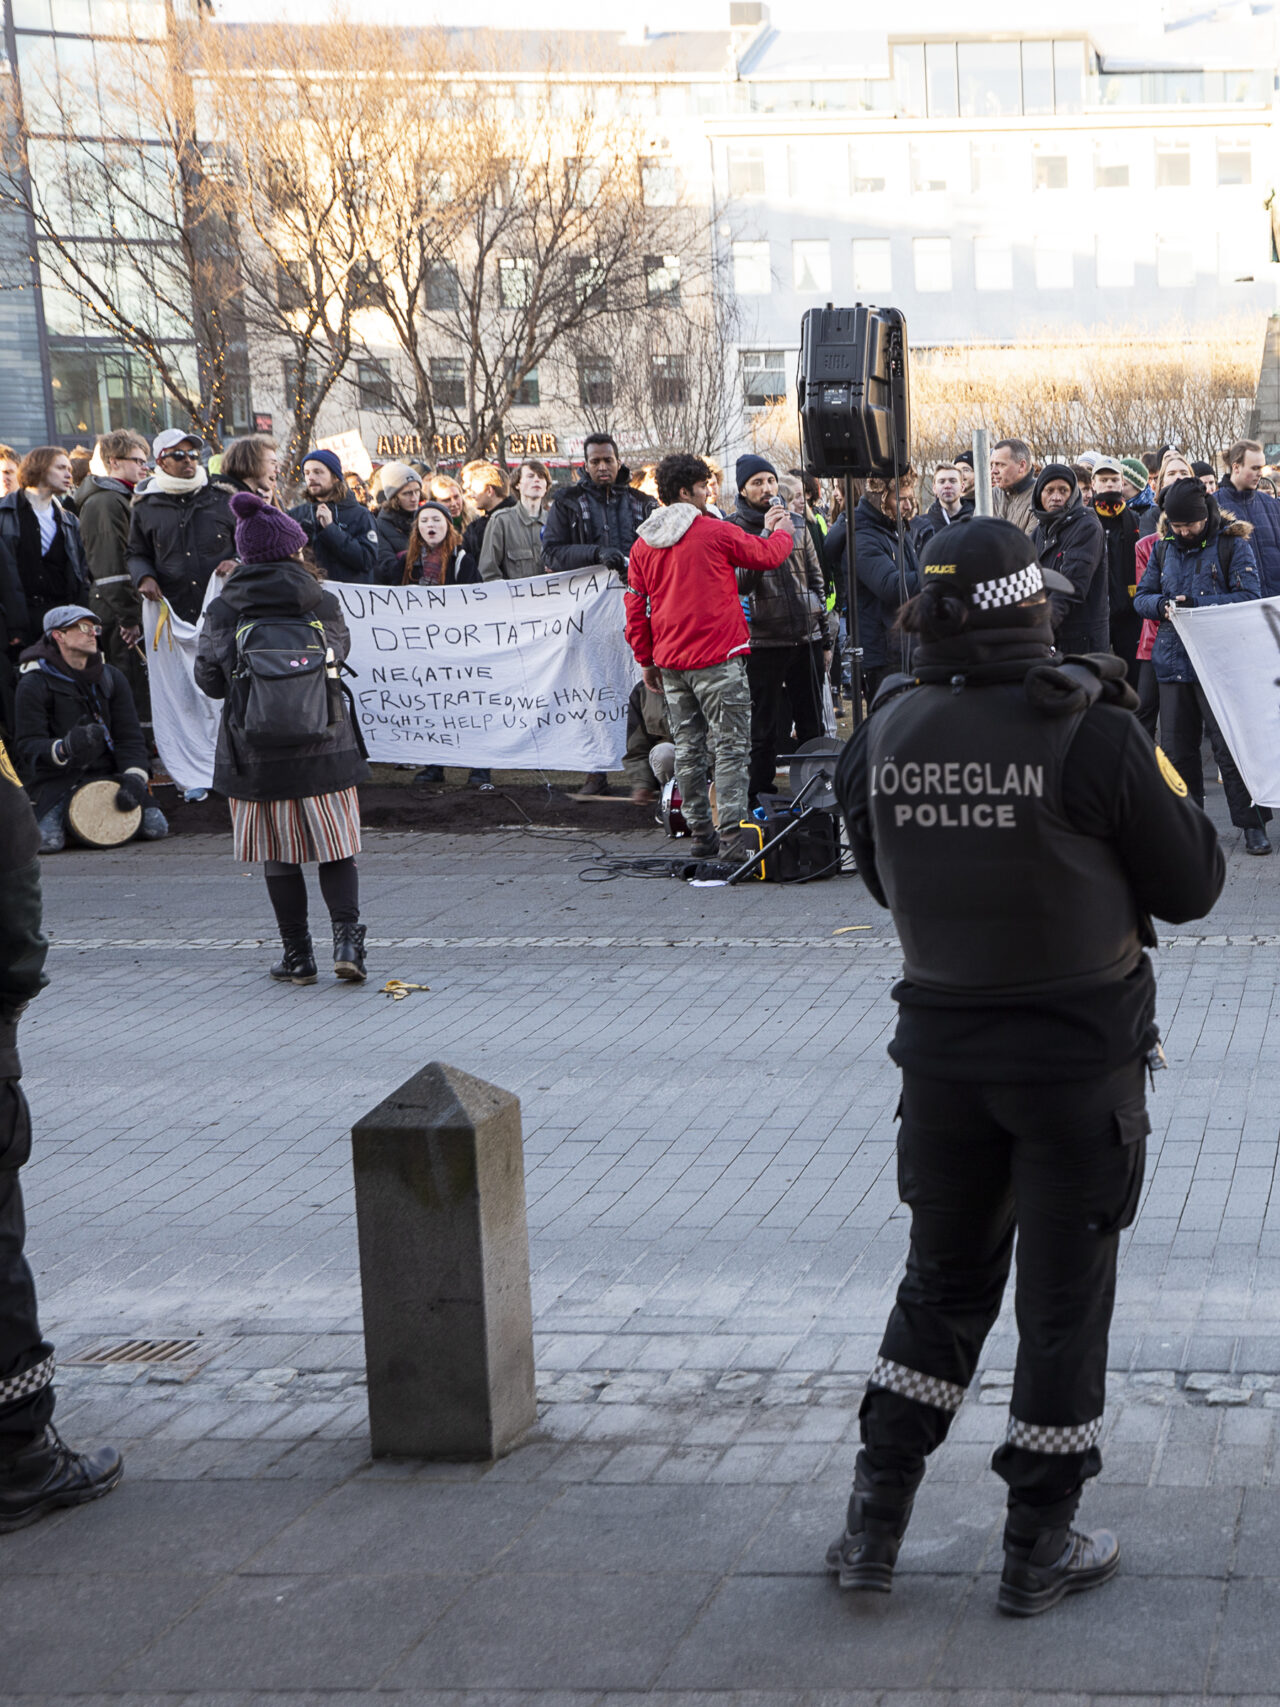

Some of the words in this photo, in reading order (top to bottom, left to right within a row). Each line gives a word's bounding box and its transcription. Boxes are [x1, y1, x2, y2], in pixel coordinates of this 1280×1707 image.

[377, 433, 499, 455] AMRIC
[924, 564, 957, 575] POLICE
[460, 587, 488, 605] IS
[371, 610, 585, 651] DEPORTATION
[372, 665, 494, 688] NEGATIVE
[553, 686, 617, 706] HAVE
[444, 713, 493, 731] HELP
[502, 714, 528, 729] US
[388, 730, 460, 748] STAKE!
[871, 756, 1044, 797] LÖGREGLAN
[894, 803, 1016, 827] POLICE
